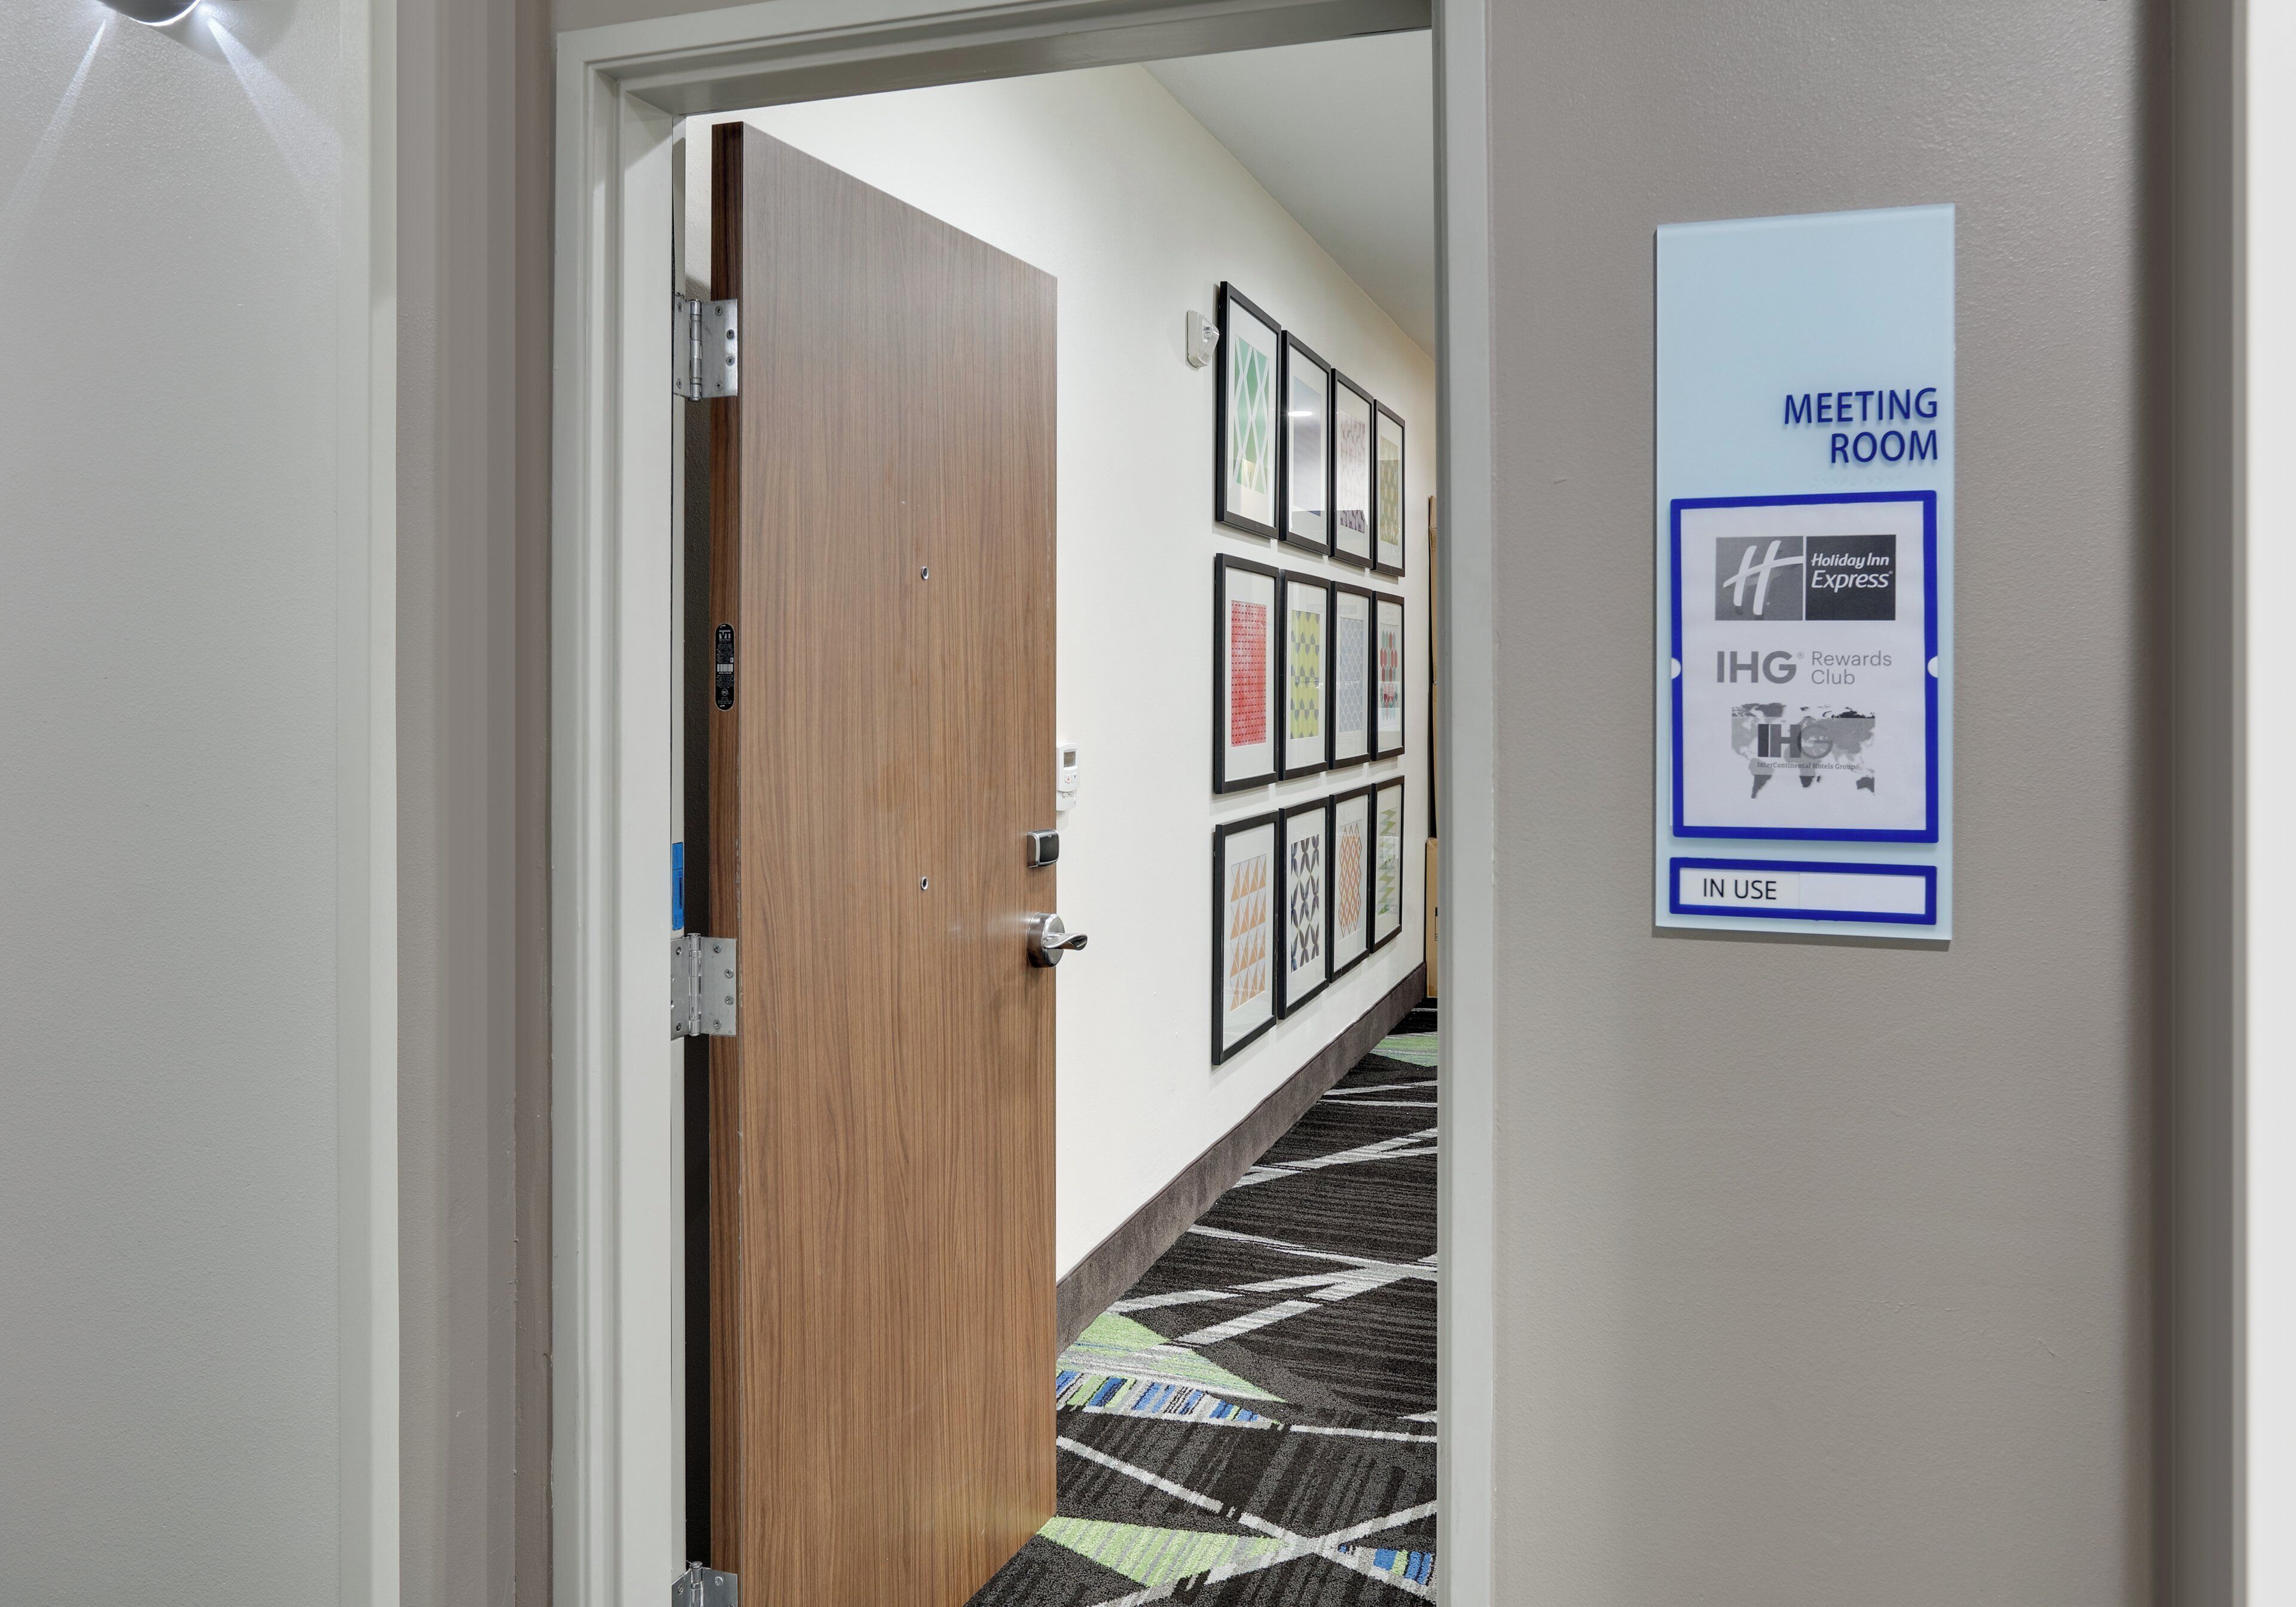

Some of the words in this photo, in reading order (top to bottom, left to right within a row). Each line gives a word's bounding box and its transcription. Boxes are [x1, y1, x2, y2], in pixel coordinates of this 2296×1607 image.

[1785, 387, 1937, 424] MEETING
[1831, 430, 1938, 463] ROOM
[1810, 552, 1865, 569] Holiday
[1867, 552, 1889, 566] Inn
[1811, 570, 1889, 593] Express
[1812, 650, 1892, 667] Rewards
[1811, 669, 1855, 685] Club
[1757, 723, 1834, 760] IHG
[1757, 761, 1811, 769] InterContinental
[1834, 763, 1856, 771] Group
[1703, 878, 1724, 897] IN
[1734, 879, 1777, 900] USE
